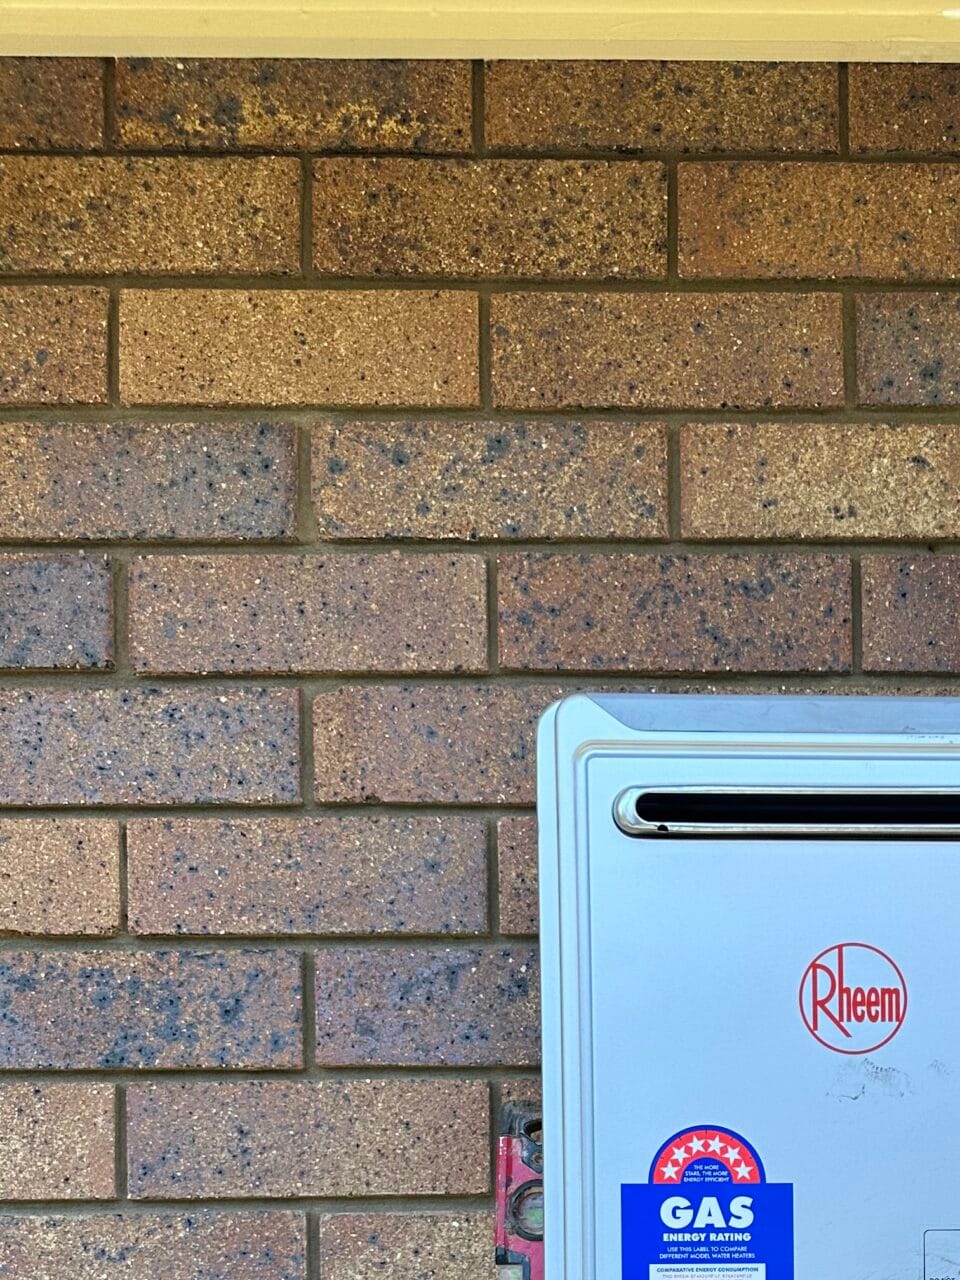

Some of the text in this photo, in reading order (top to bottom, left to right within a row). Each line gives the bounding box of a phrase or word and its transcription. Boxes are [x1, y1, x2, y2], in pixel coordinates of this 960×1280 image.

[811, 945, 901, 1037] Rheem
[660, 1196, 754, 1229] GAS
[663, 1233, 751, 1242] ENERGY RATING
